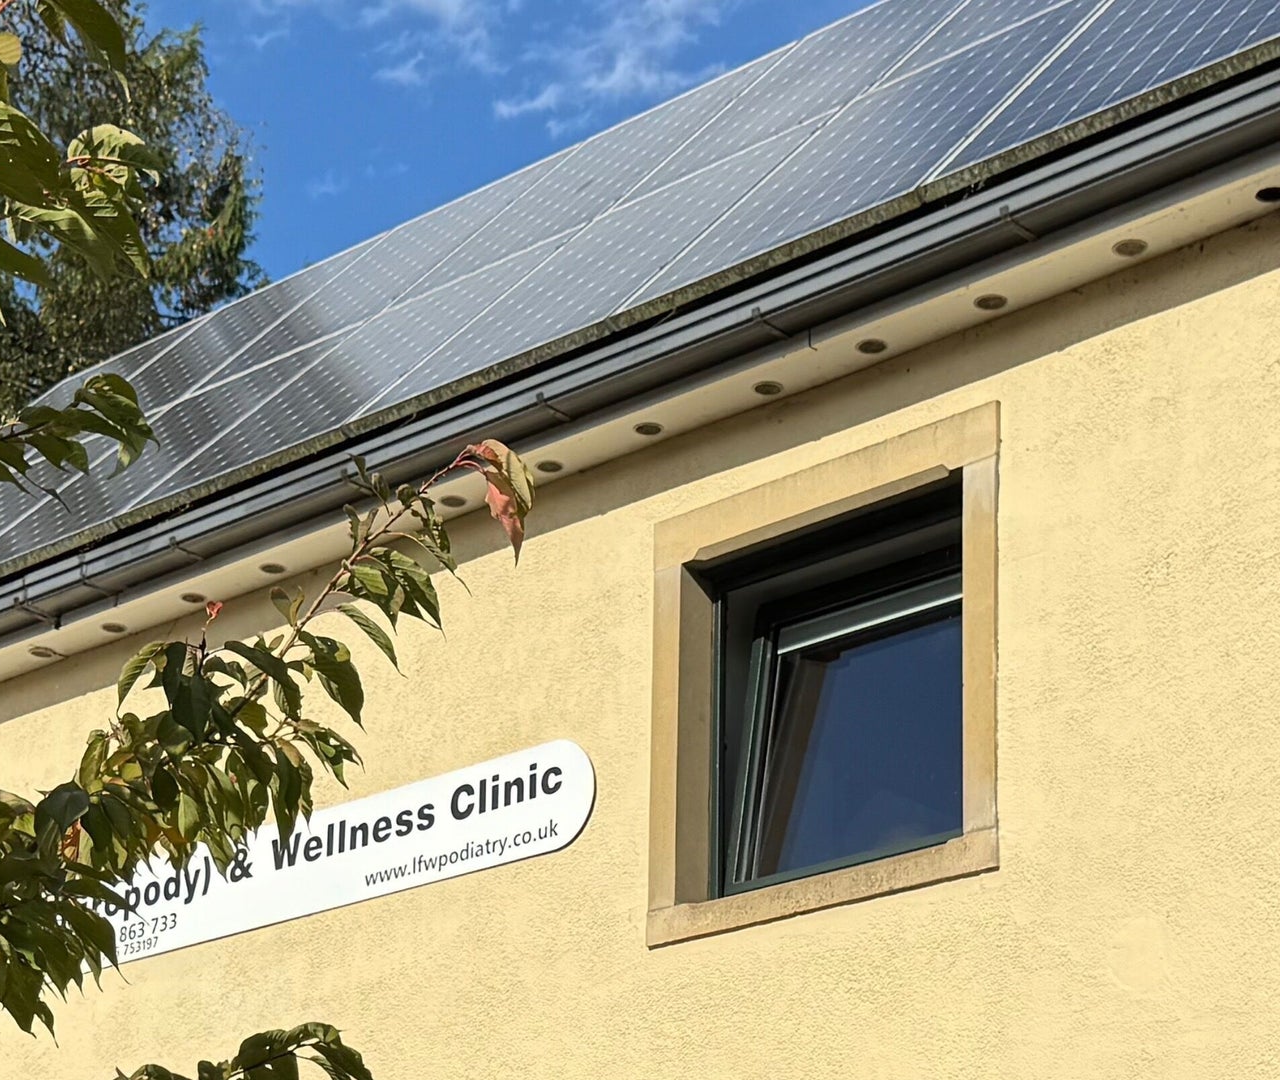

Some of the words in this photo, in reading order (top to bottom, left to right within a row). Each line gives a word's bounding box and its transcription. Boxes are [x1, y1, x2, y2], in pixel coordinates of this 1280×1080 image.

[230, 847, 253, 882] &
[272, 803, 435, 871] Wellness
[450, 763, 563, 821] Clinic
[365, 819, 558, 887] www.lfwpodiatry.co.uk
[120, 921, 145, 942] 863
[151, 912, 177, 934] 733
[123, 936, 158, 956] 753197
